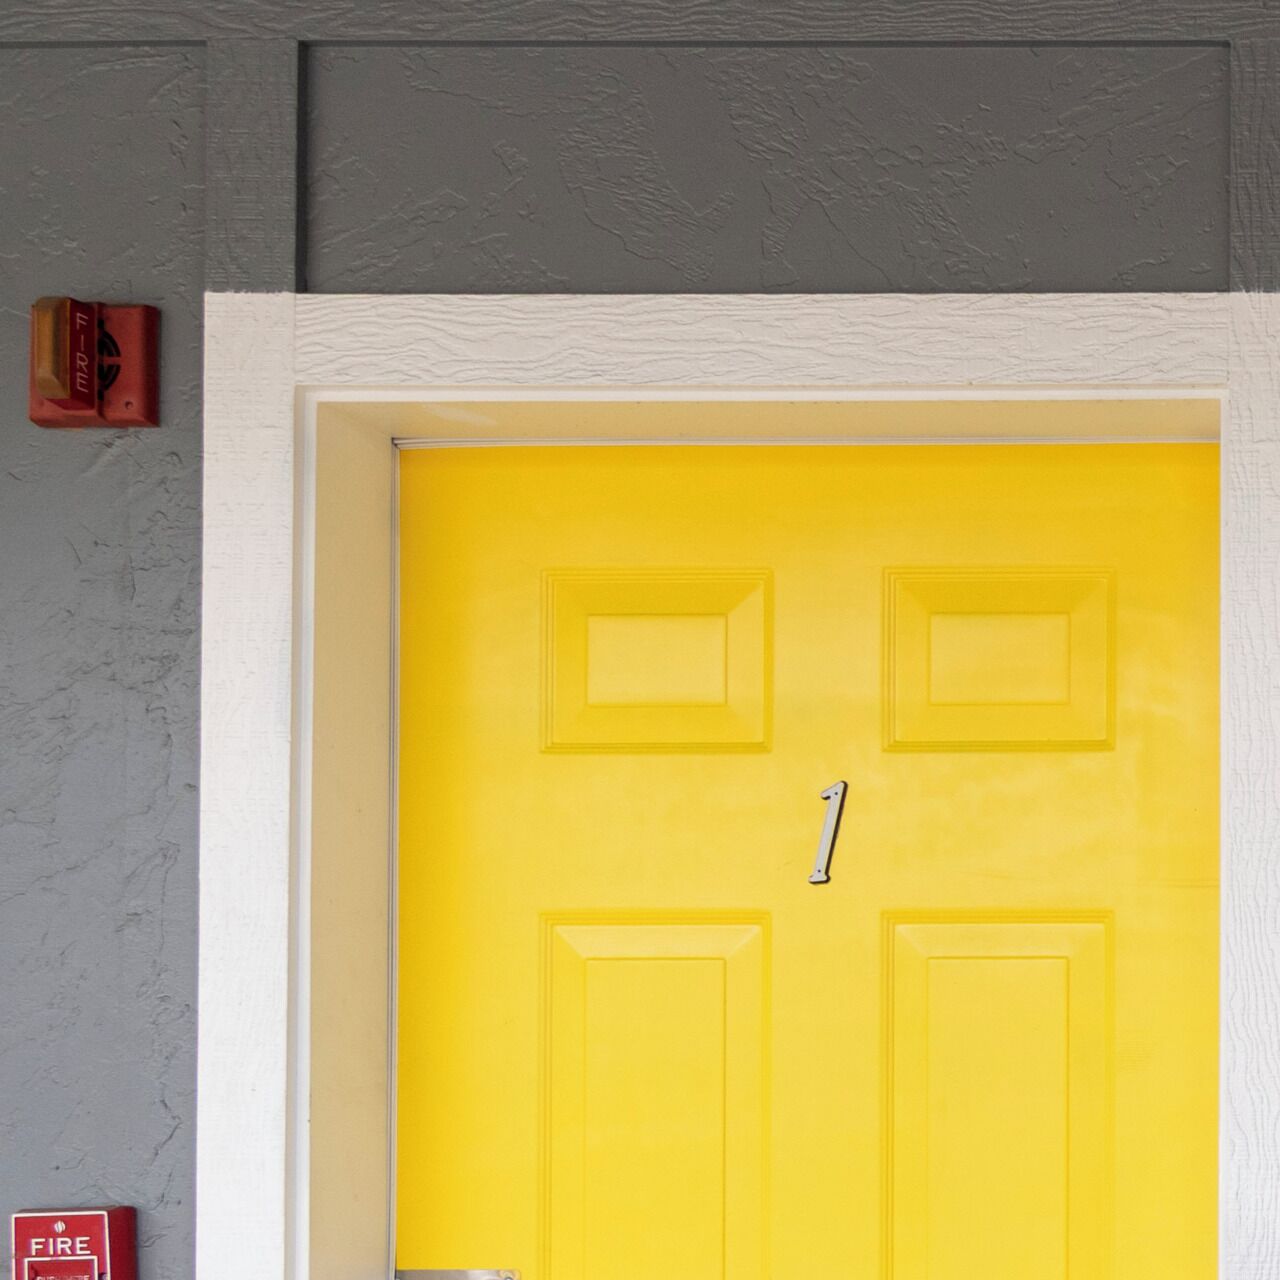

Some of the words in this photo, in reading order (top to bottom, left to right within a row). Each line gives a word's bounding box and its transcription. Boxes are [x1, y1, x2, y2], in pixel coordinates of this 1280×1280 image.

[76, 312, 89, 393] FIRE
[808, 780, 847, 884] 1
[31, 1236, 91, 1256] FIRE
